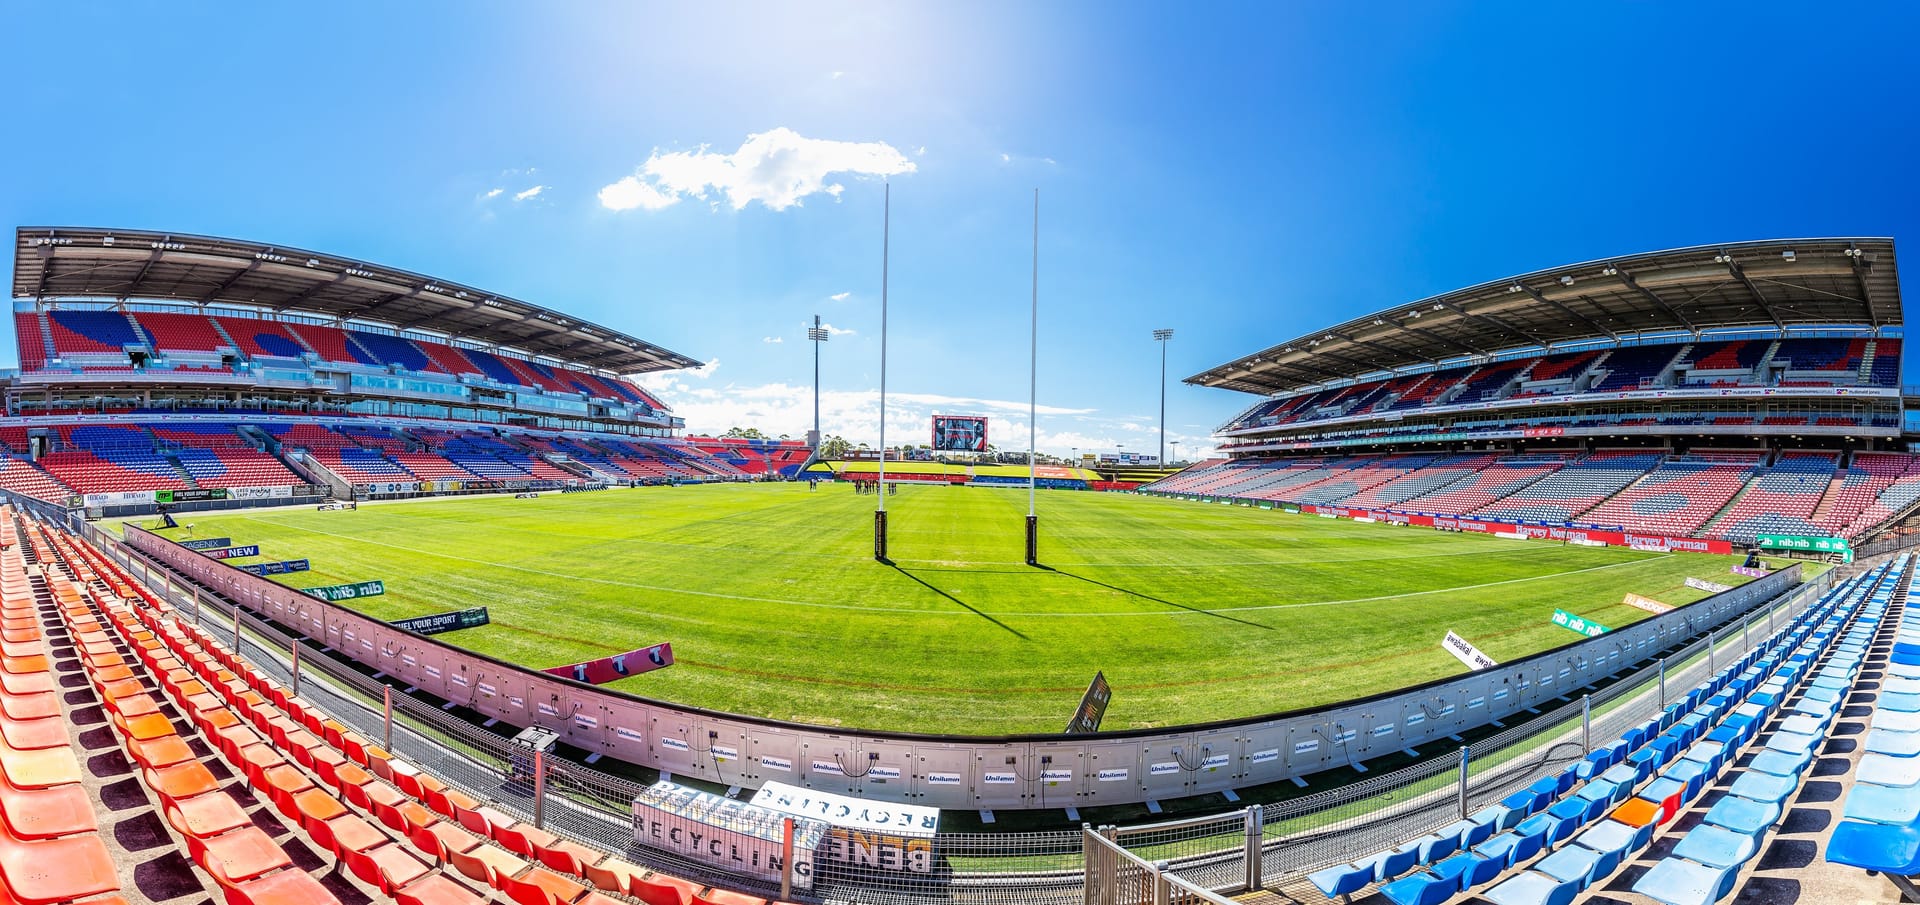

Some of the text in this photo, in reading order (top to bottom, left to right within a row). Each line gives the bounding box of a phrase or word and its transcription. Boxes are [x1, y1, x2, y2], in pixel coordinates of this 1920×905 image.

[1434, 518, 1456, 528] Harvey
[1458, 520, 1486, 530] Norman
[1516, 525, 1587, 541] Harvey Norman
[1624, 534, 1708, 550] Harvey Norman
[1779, 539, 1793, 547] nib
[1795, 539, 1809, 548] nib
[1816, 540, 1829, 549] nib
[1833, 541, 1845, 550] nib
[228, 547, 254, 557] NEW
[333, 586, 355, 599] nib
[360, 582, 382, 595] nib
[412, 618, 432, 629] YOUR
[433, 614, 456, 626] SPORT
[1552, 612, 1568, 625] nib
[1568, 619, 1585, 631] nib
[1447, 635, 1472, 656] awabakal
[618, 728, 640, 740] Unilumin
[663, 738, 688, 749] Unilumin
[711, 747, 737, 758] Unilumin
[762, 759, 791, 769] Unilumin
[813, 763, 843, 772] Unilumin
[1151, 764, 1179, 773] Unilumin
[869, 768, 899, 777] Unilumin
[1041, 772, 1071, 780] Unilumin
[929, 774, 960, 783] Unilumin
[633, 814, 811, 876] RECYCLING
